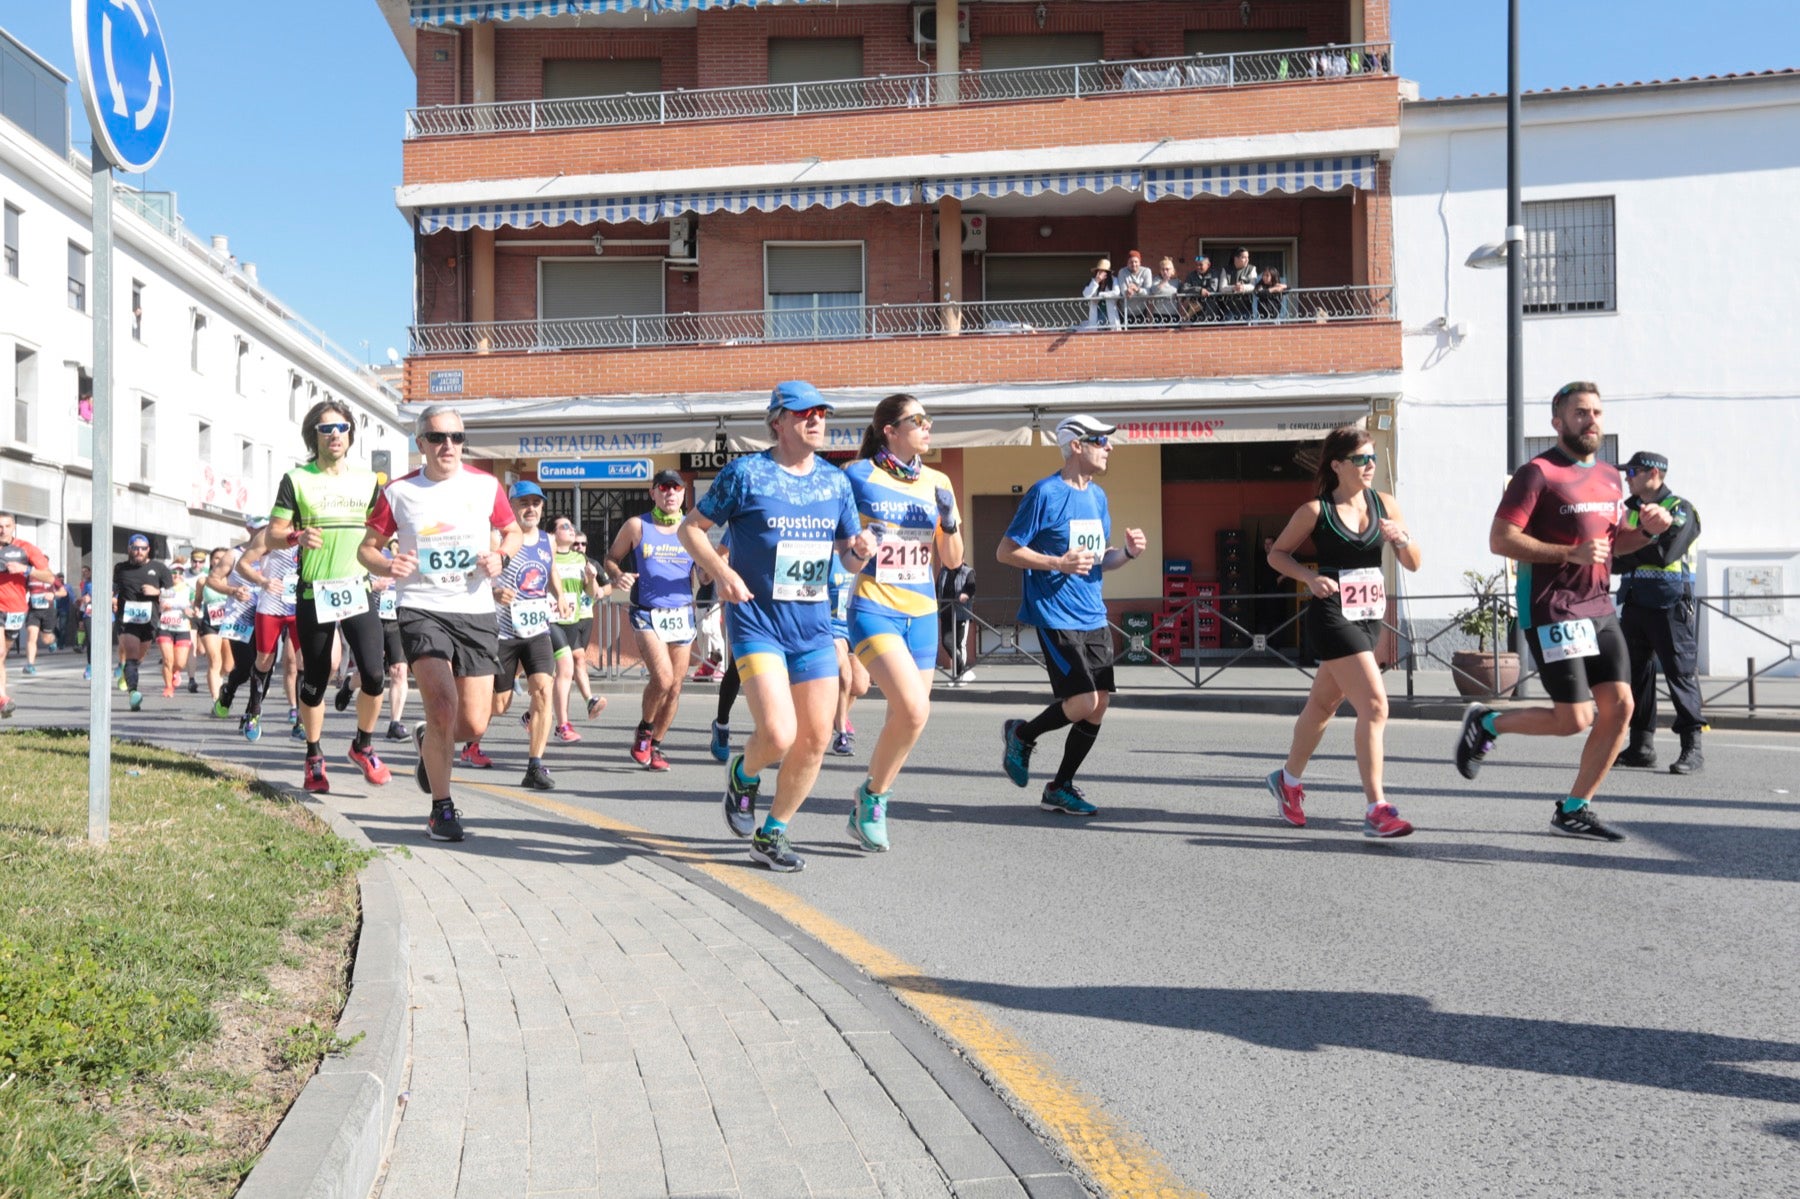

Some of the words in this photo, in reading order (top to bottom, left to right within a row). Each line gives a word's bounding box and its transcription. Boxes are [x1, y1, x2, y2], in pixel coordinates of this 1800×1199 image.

[1289, 422, 1321, 430] CERVEZAS
[518, 432, 663, 453] RESTAURANTE
[541, 465, 586, 475] Granada
[610, 465, 630, 474] A-44
[871, 501, 936, 516] agustinos
[767, 515, 836, 532] agustinos
[780, 530, 827, 538] GRANADA
[1077, 534, 1100, 550] 901
[429, 549, 470, 570] 632
[880, 546, 929, 565] 2118
[786, 560, 825, 581] 492
[331, 589, 352, 607] 89
[519, 611, 546, 626] 388
[660, 617, 684, 631] 453
